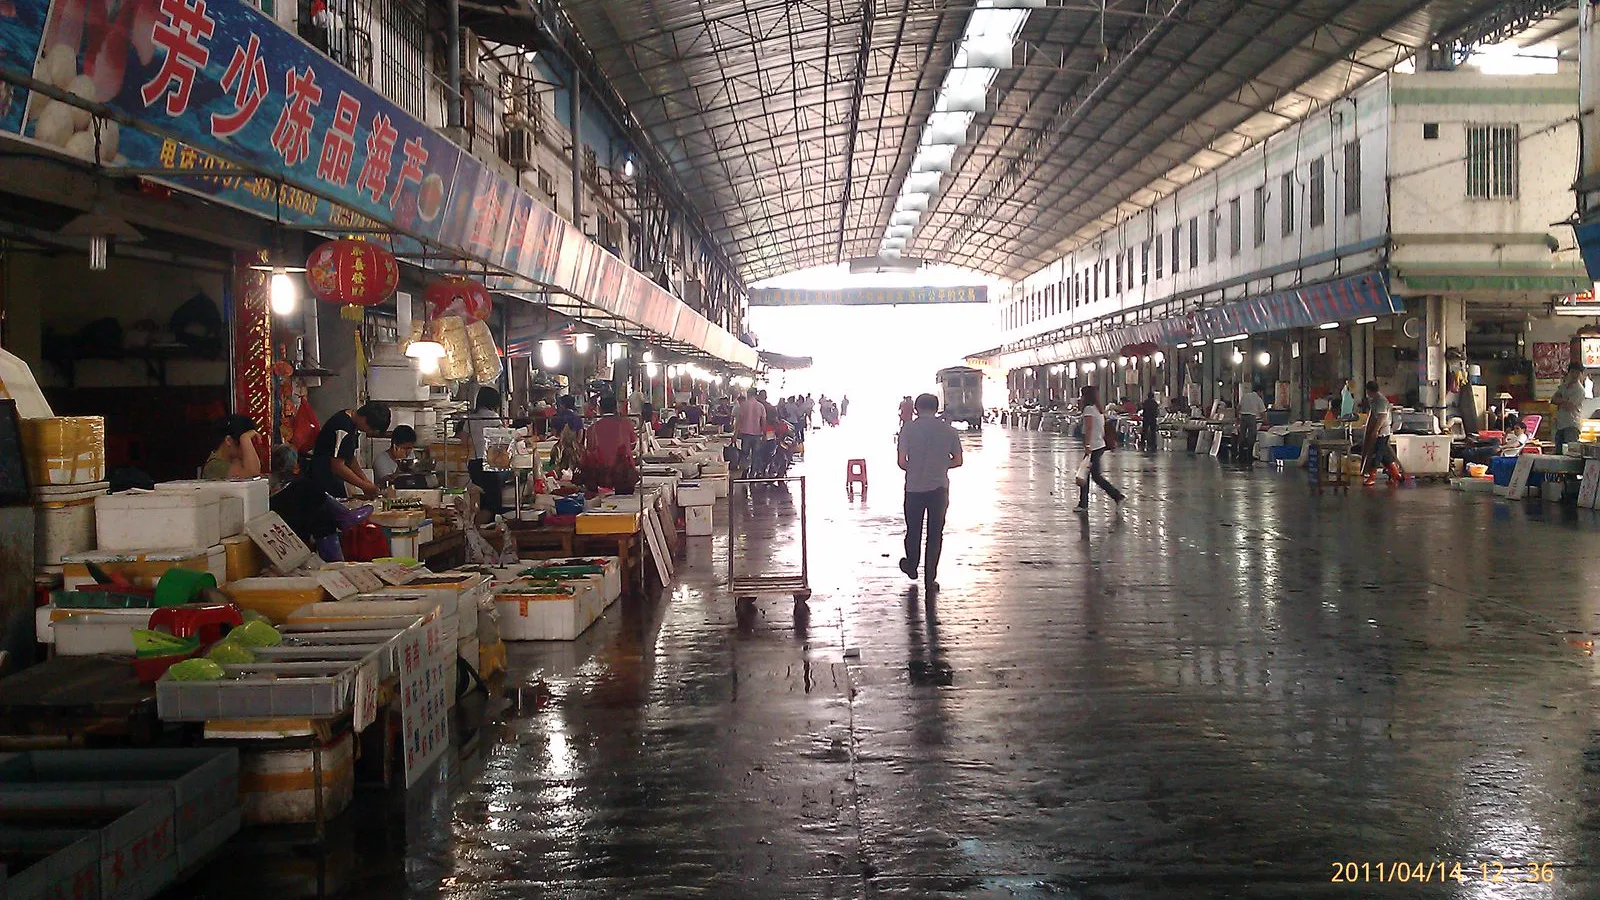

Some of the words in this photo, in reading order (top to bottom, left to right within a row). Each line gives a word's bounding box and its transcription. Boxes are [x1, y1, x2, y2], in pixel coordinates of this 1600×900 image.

[141, 0, 430, 209] 芳少冻品海产
